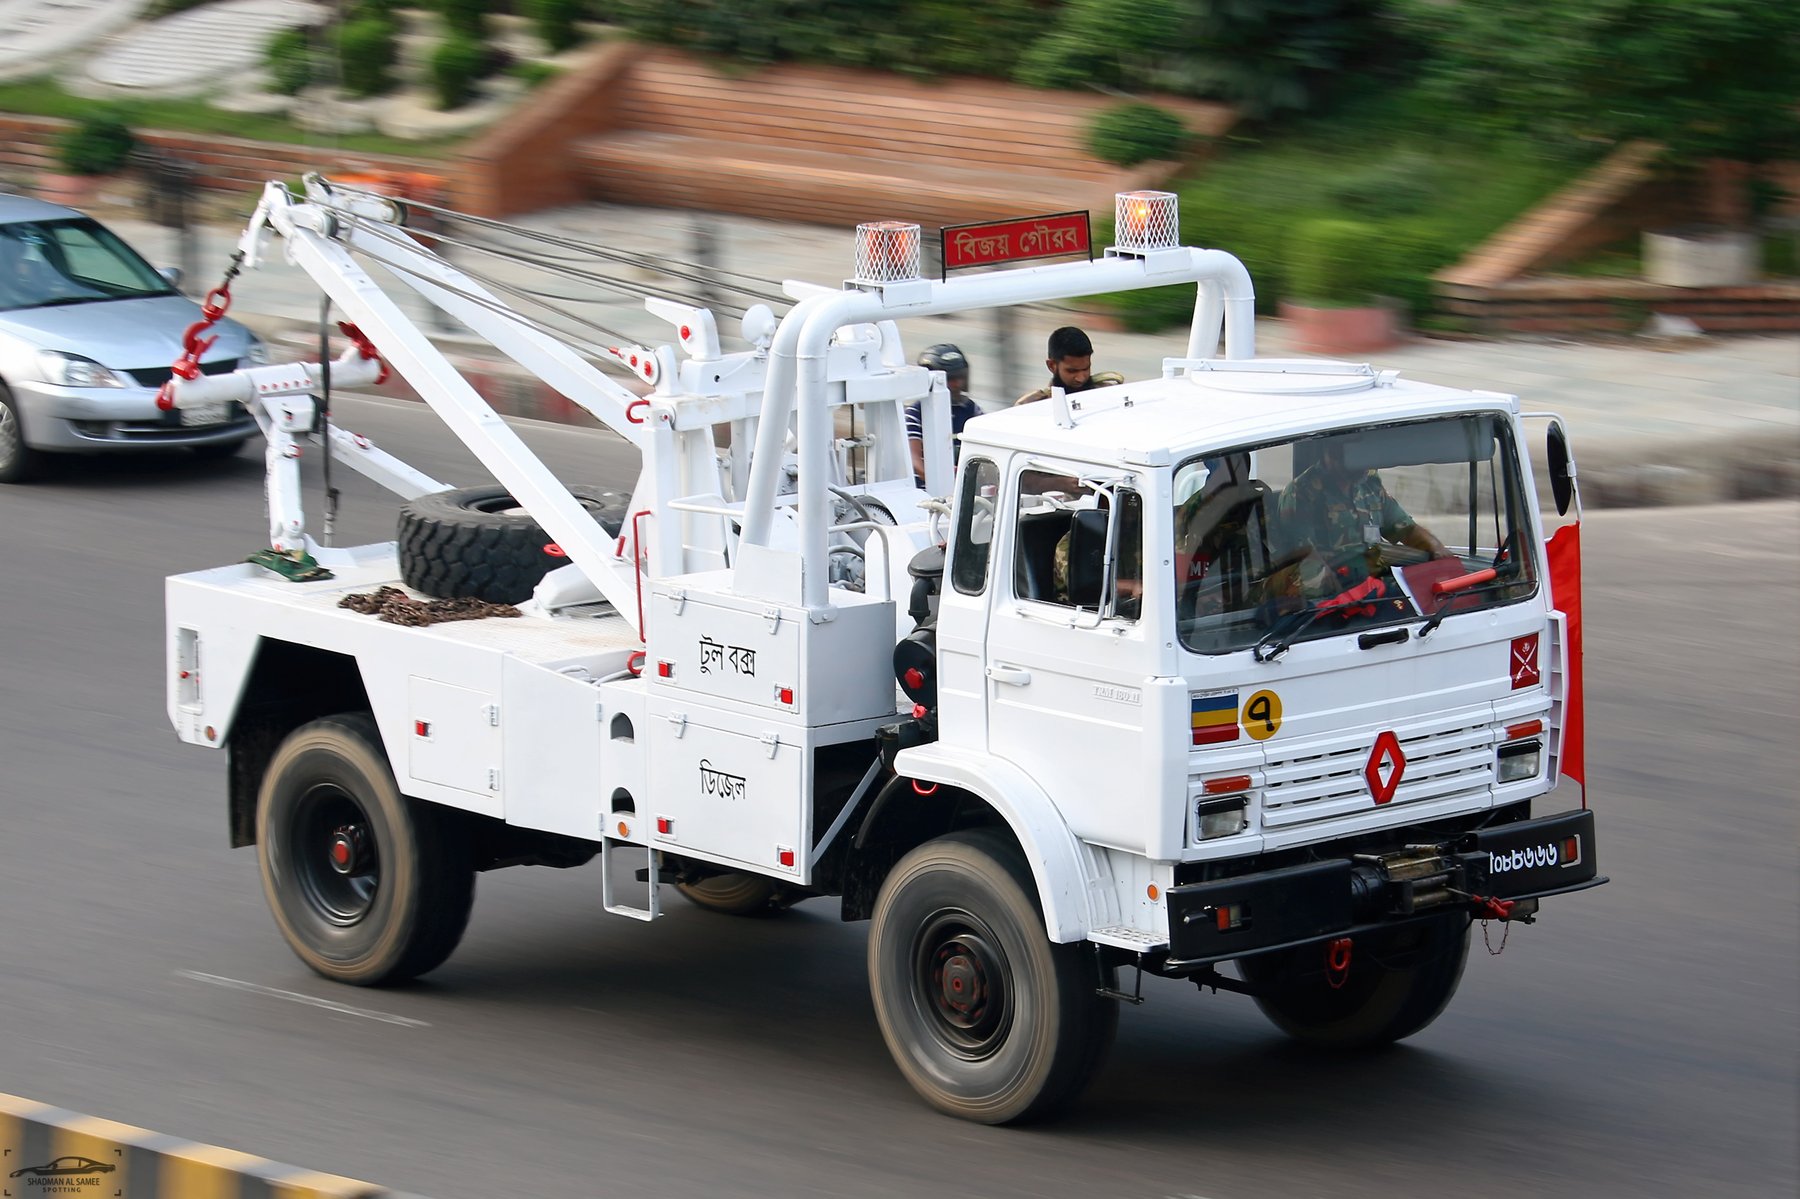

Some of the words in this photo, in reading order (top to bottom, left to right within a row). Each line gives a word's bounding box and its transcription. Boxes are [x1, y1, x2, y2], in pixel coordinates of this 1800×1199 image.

[954, 231, 1010, 261] বিজয়
[1019, 223, 1078, 253] গৌরব
[699, 634, 724, 675] টুল
[728, 645, 756, 678] বক্স
[699, 758, 746, 800] ডিজেল
